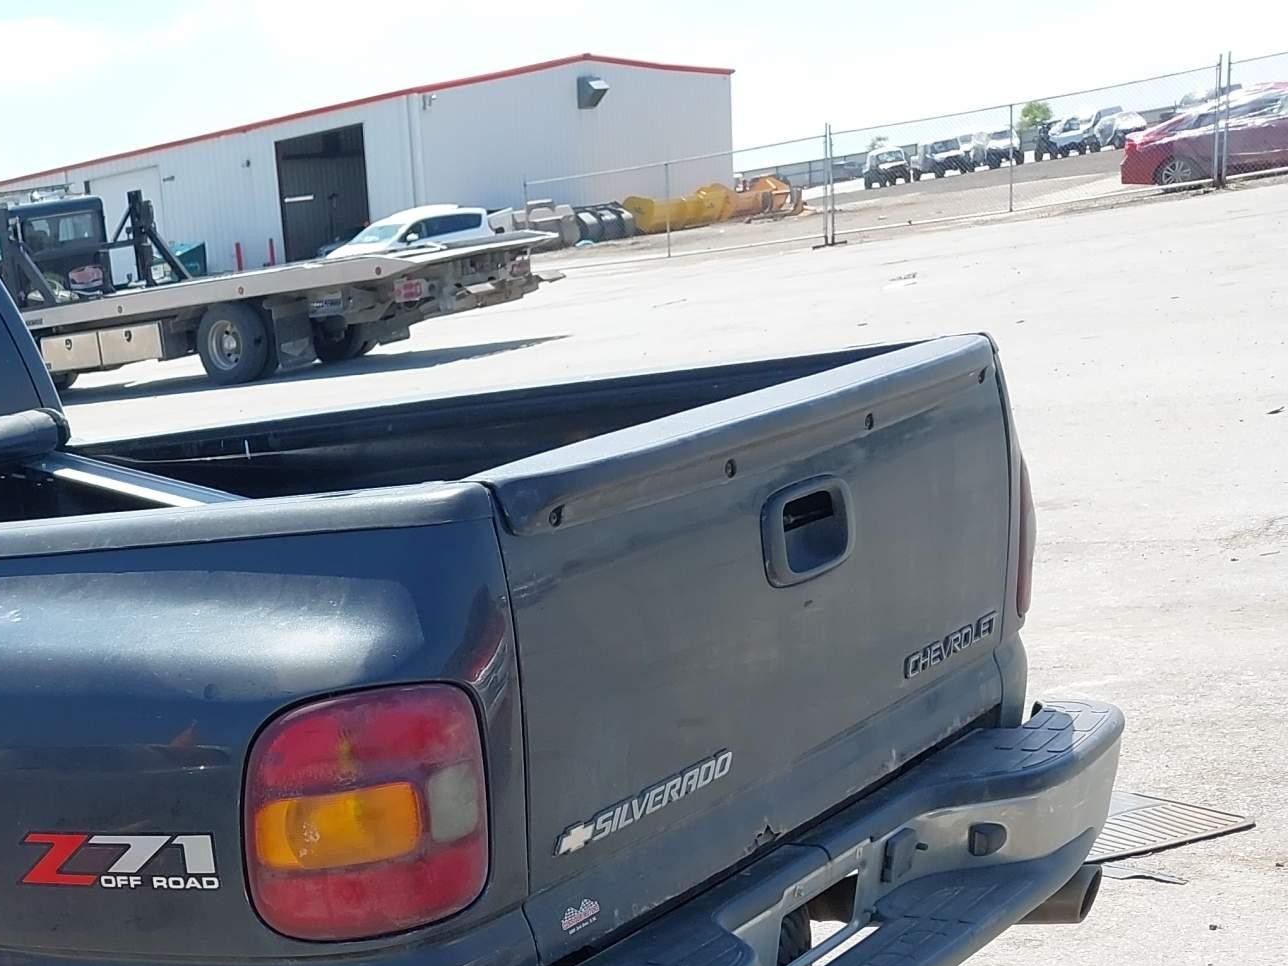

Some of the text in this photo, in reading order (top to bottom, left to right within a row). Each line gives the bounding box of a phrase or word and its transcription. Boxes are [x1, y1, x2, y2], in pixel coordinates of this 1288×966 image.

[904, 610, 999, 680] CHEVROLET
[592, 750, 733, 841] SILVERADO
[20, 833, 217, 887] Z71
[100, 875, 220, 890] OFF ROAD
